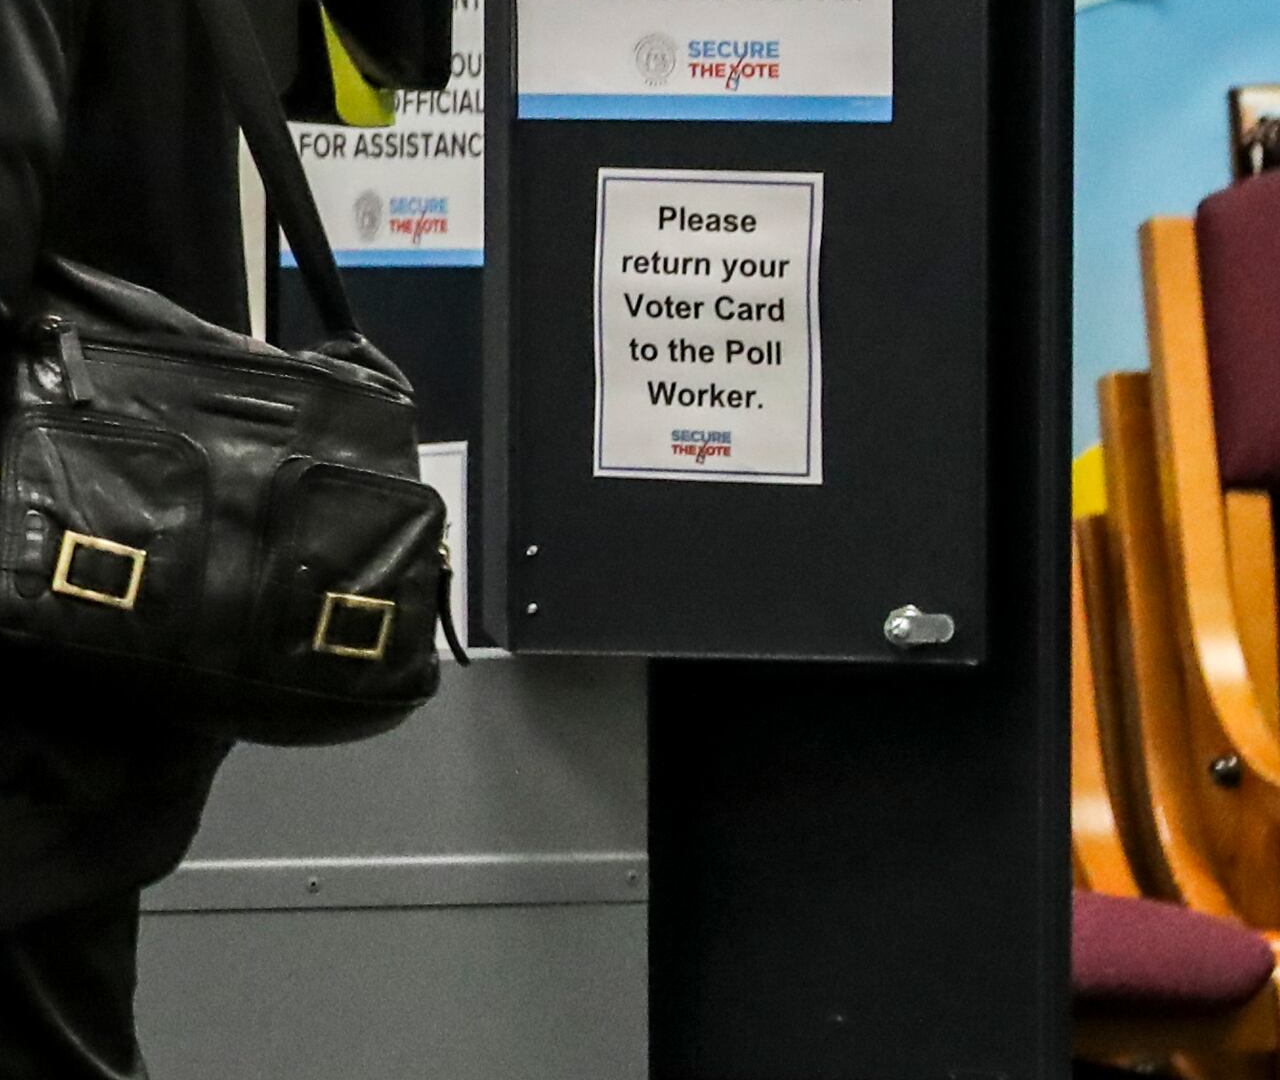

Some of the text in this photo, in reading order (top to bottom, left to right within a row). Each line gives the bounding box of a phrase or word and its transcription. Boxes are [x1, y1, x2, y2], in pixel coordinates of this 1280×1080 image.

[688, 40, 780, 58] SECURE
[689, 63, 725, 78] THE
[393, 90, 484, 115] FFICIAL
[300, 134, 346, 158] FOR
[390, 197, 447, 213] SECURE
[658, 206, 757, 233] Please
[622, 251, 790, 283] return your
[624, 293, 785, 322] Voter Card
[629, 338, 781, 365] to the Poll
[648, 381, 763, 409] Worker.
[672, 430, 731, 444] SECURE
[672, 444, 697, 456] THE
